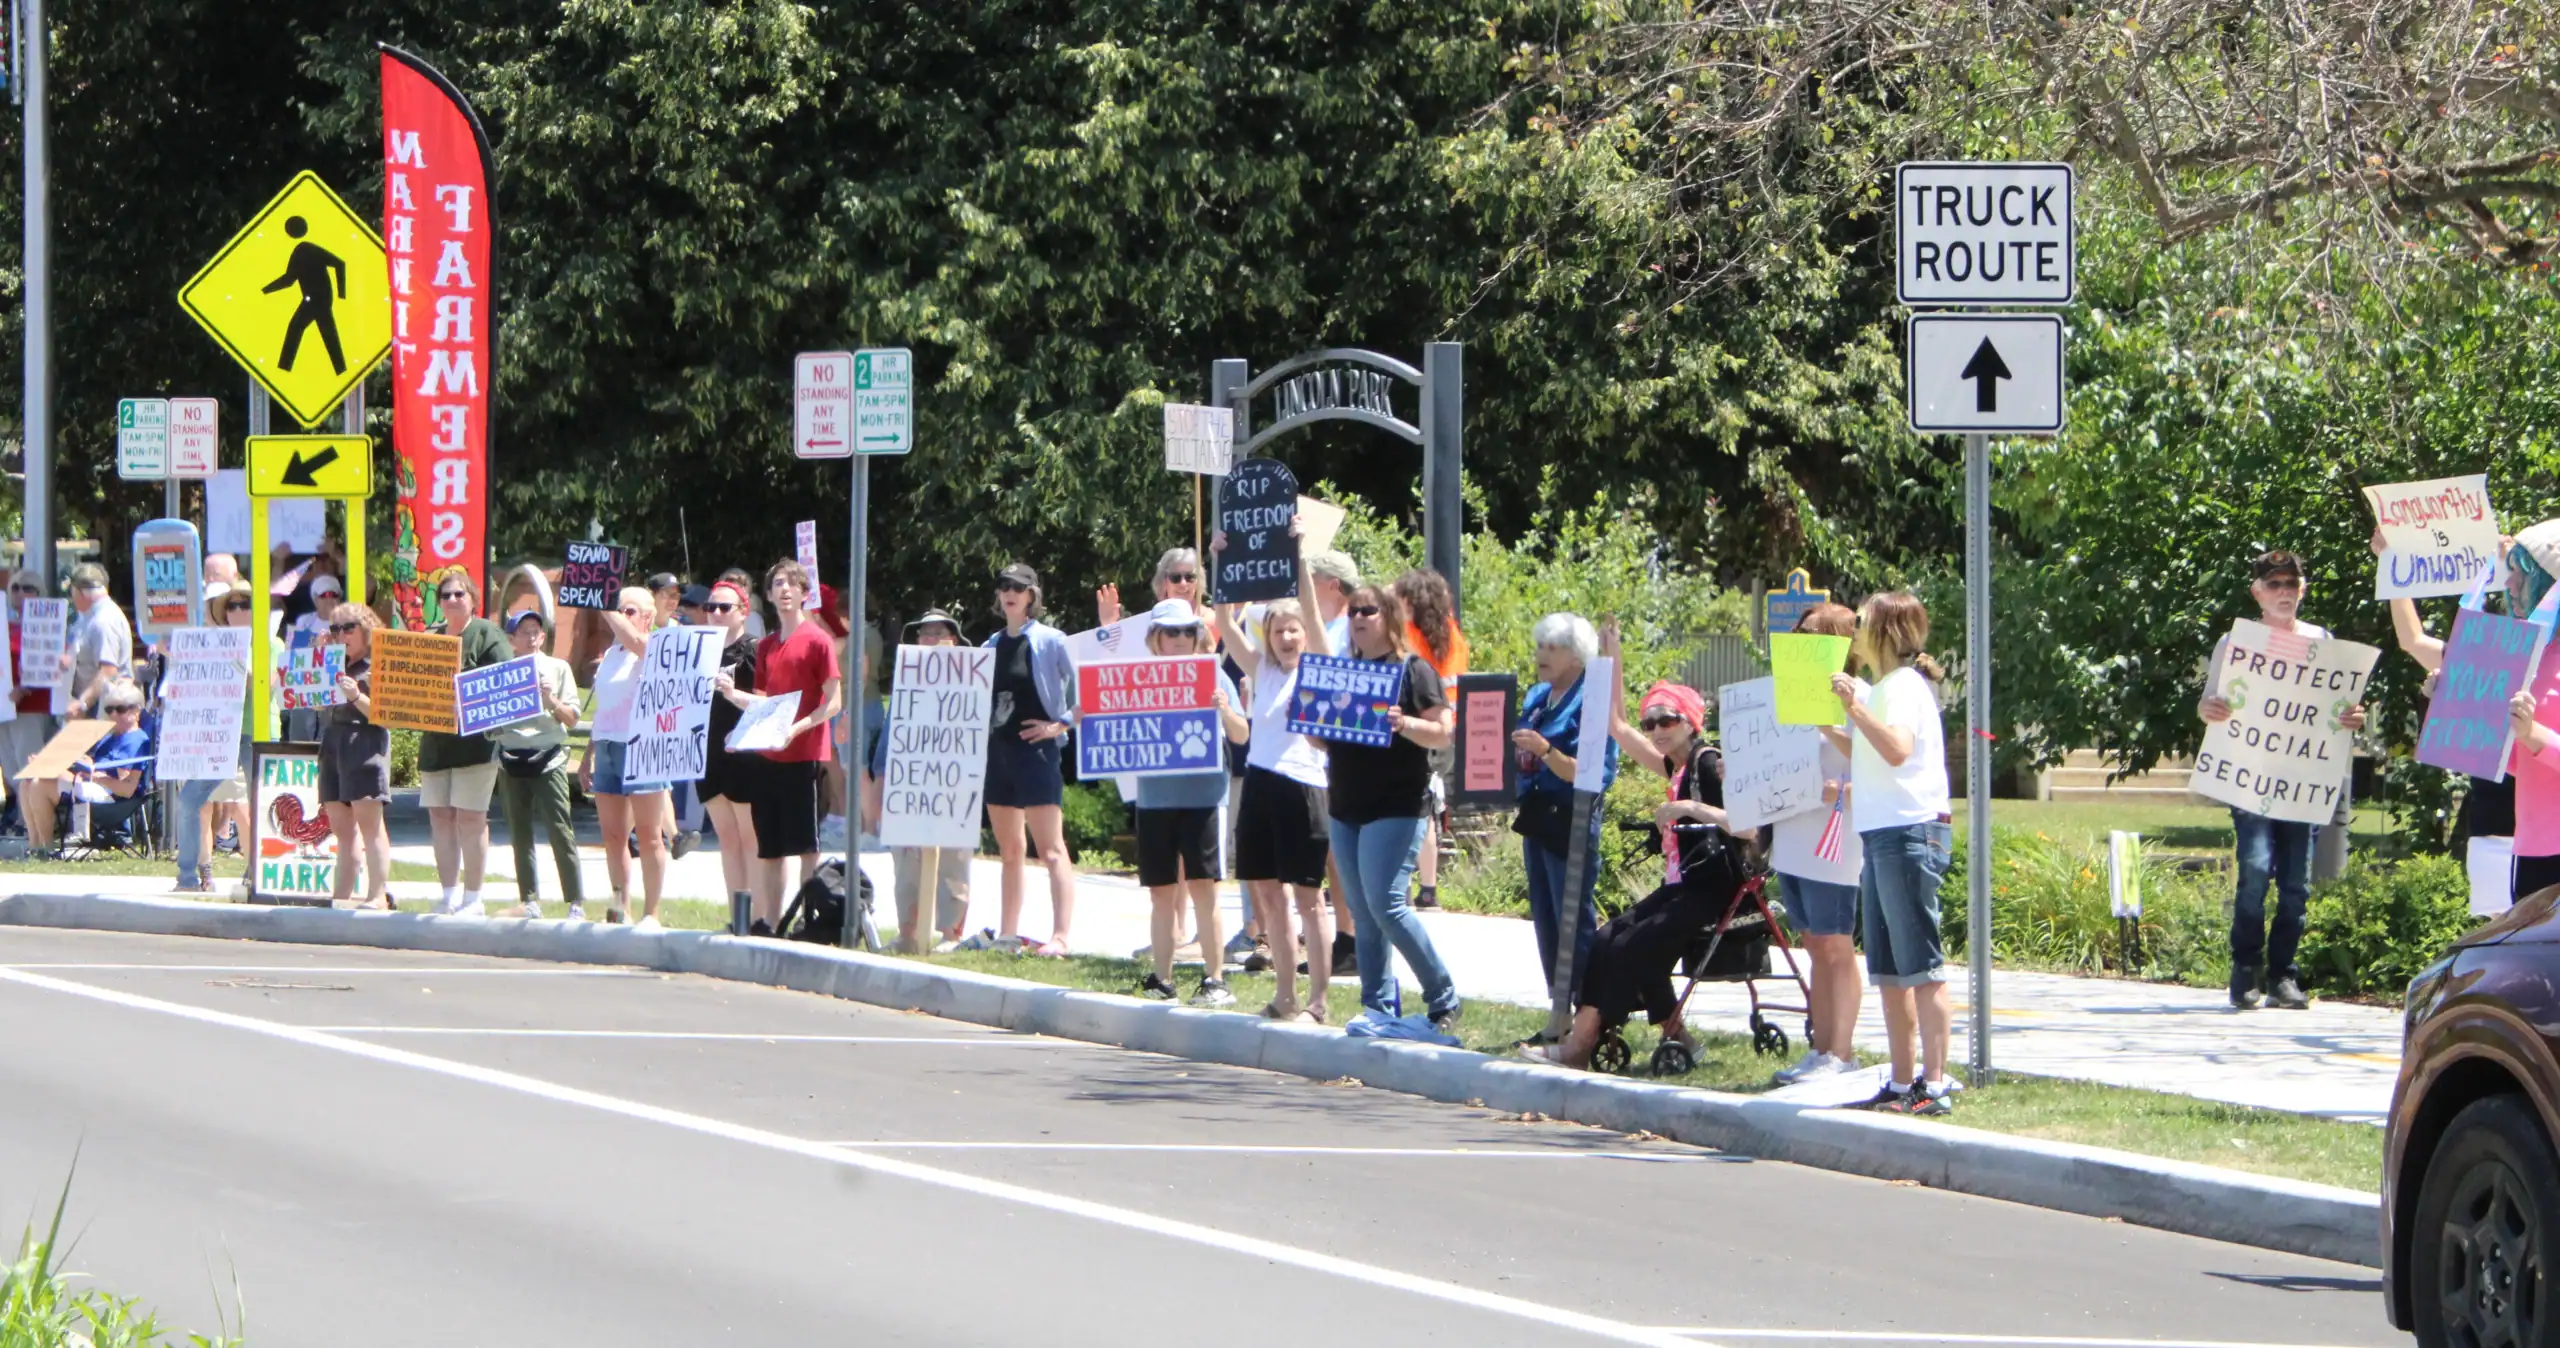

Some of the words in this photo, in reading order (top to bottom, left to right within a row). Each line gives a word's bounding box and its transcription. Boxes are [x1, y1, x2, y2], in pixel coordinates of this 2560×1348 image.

[1909, 185, 2057, 226] TRUCK
[1915, 241, 2060, 282] ROUTE
[813, 365, 834, 382] NO
[858, 359, 868, 385] 2
[882, 357, 896, 369] HR
[873, 371, 907, 383] PARKING
[800, 388, 848, 400] STANDING
[858, 394, 906, 407] 7AM-5PM
[1274, 369, 1341, 421] LINCOLN
[1349, 369, 1393, 418] PARK
[123, 404, 132, 425] 2
[136, 415, 165, 425] PARKING
[143, 404, 156, 414] HR
[184, 406, 202, 421] NO
[813, 405, 834, 418] ANY
[860, 413, 905, 426] MON-FRI
[124, 432, 164, 442] 7AM-5PM
[173, 424, 213, 435] STANDING
[812, 422, 836, 435] TIME
[125, 447, 162, 457] MON-FRI
[184, 438, 201, 447] ANY
[183, 451, 202, 461] TIME
[1237, 477, 1270, 499] RIP
[1223, 503, 1295, 533] FREEDOM
[1248, 531, 1267, 550] OF
[2431, 528, 2450, 547] is
[568, 544, 610, 564] STAND
[564, 563, 607, 586] RISE
[1223, 558, 1291, 582] SPEECH
[2391, 546, 2495, 587] Unworthy
[560, 586, 604, 609] SPEAK
[312, 645, 344, 668] NOT
[644, 631, 717, 676] FIGHT
[277, 665, 321, 688] YOURS
[901, 652, 989, 689] HONK
[1097, 666, 1128, 688] MY
[1132, 663, 1172, 686] CAT
[1177, 662, 1198, 683] IS
[2230, 647, 2363, 692] PROTECT
[463, 666, 531, 697] TRUMP
[1300, 667, 1394, 699] RESIST!
[283, 688, 337, 709] SILENCE
[489, 690, 510, 702] FOR
[636, 676, 714, 719] IGNORANCE
[893, 688, 925, 720] IF
[935, 690, 980, 722] YOU
[1099, 686, 1198, 710] SMARTER
[466, 693, 535, 725] PRISON
[656, 706, 683, 733] NOT
[2264, 698, 2319, 726] OUR
[893, 724, 983, 755] SUPPORT
[1094, 716, 1162, 744] THAN
[2227, 719, 2329, 761] SOCIAL
[625, 723, 705, 780] IMMIGRANTS
[1087, 743, 1173, 770] TRUMP
[263, 758, 320, 788] FARM
[2197, 752, 2337, 805] SECURITY
